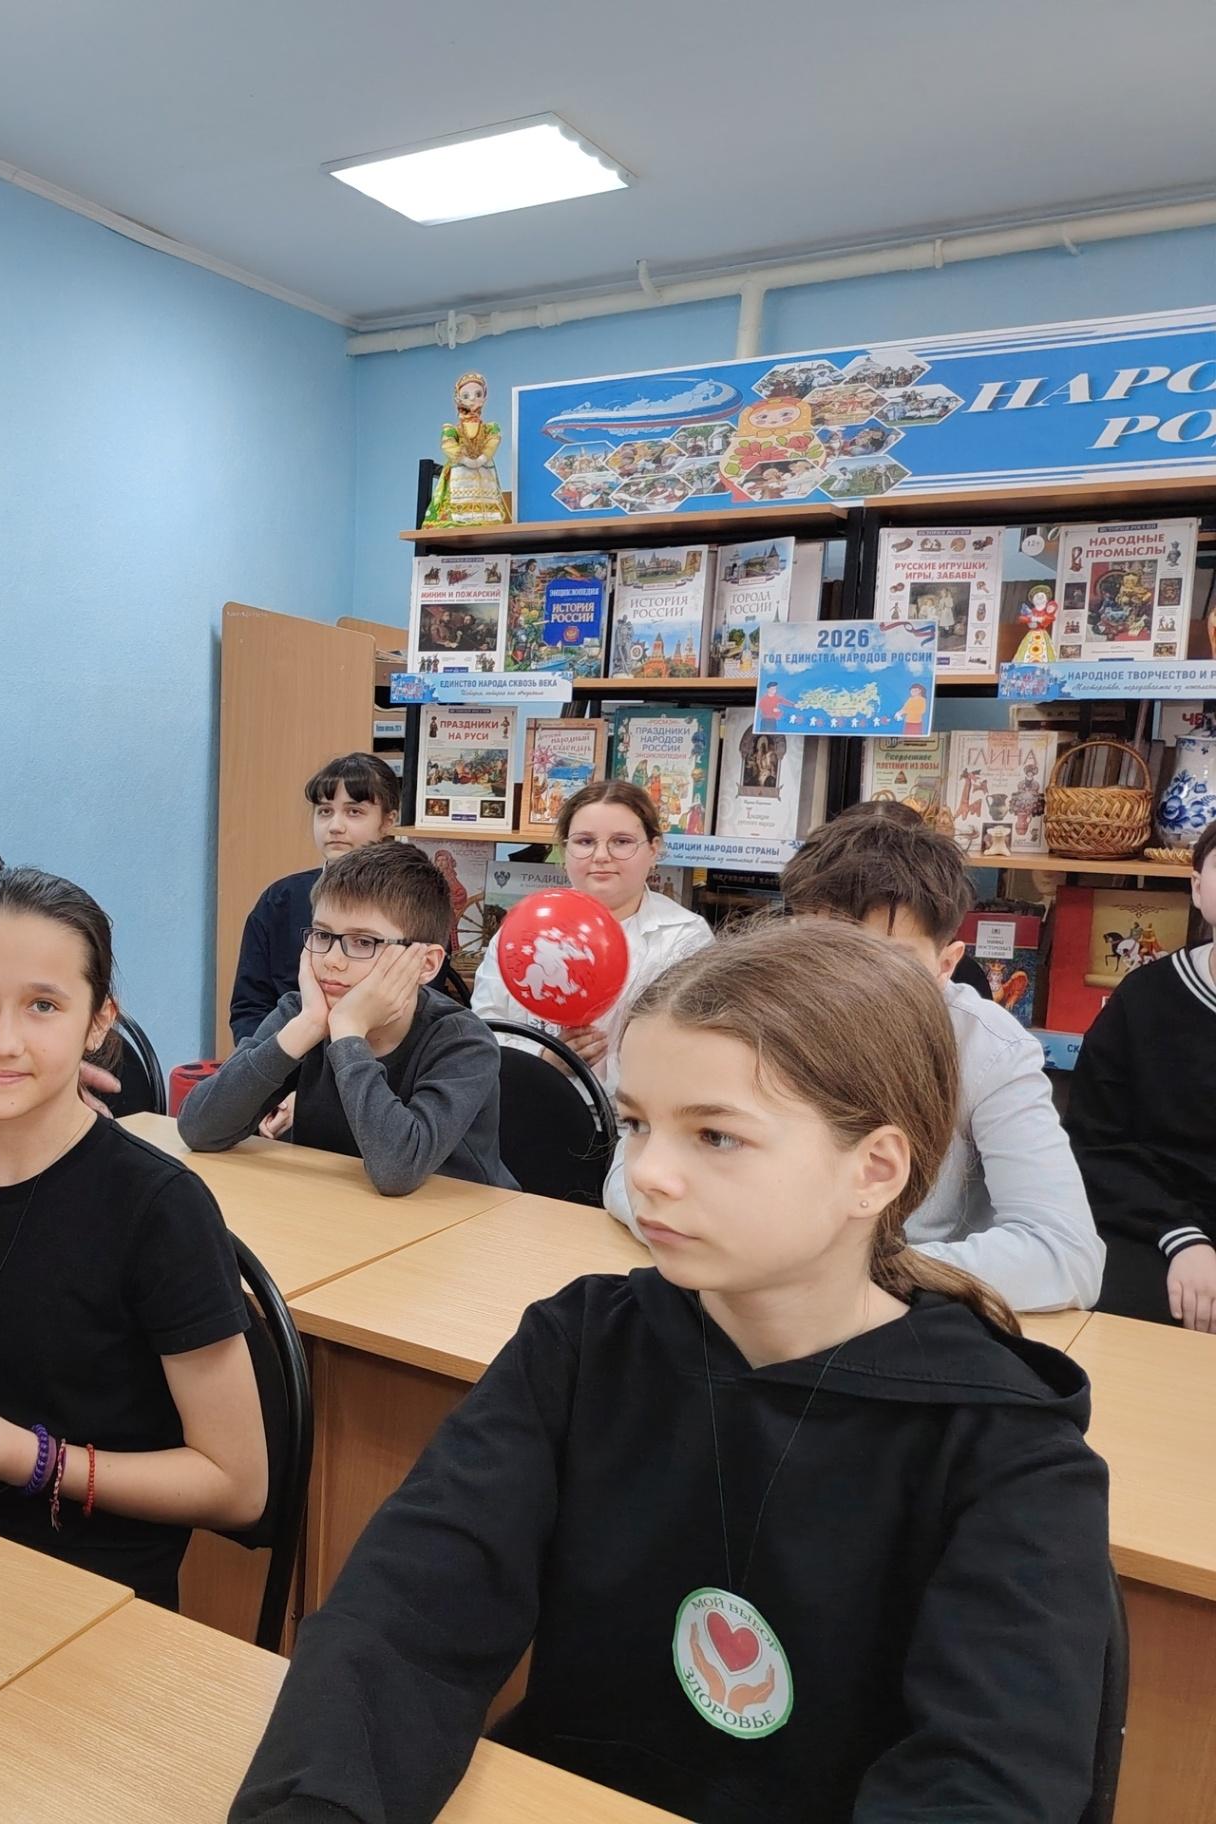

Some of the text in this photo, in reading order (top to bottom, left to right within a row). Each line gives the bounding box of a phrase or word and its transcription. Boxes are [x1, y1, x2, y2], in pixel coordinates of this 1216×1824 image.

[1086, 409, 1216, 449] РО
[1088, 533, 1165, 547] НАРОДНЫЕ
[1085, 545, 1167, 558] ПРОМЫСЛЫ
[894, 562, 937, 571] РУССКИЕ
[937, 571, 977, 579] ЗАБАВЫ
[420, 591, 447, 599] МИНИН
[455, 588, 502, 599] ПОЖАРСКИЙ
[732, 590, 772, 604] ГОРОДА
[552, 602, 595, 613] ИСТОРИЯ
[630, 595, 689, 609] ИСТОРИЯ
[633, 606, 685, 619] РОССИИ
[729, 602, 773, 616] РОССИИ
[550, 612, 595, 624] РОССИИ
[817, 628, 871, 648] 2026
[763, 654, 782, 665] ГОД
[785, 653, 836, 664] ЕДИНСТВА
[839, 652, 887, 663] НАРОДОВ
[890, 651, 933, 662] РОССИИ
[1068, 671, 1125, 681] НАРОДНОЕ
[1127, 670, 1197, 680] ТВОРЧЕСТВО
[1199, 670, 1207, 679] И
[440, 679, 558, 688] ЕДИНСТВО НАРОДА СКВОЗЬ ВЕКА
[439, 720, 499, 730] ПРАЗДНИКИ
[635, 727, 691, 735] ПРАЗДНИКИ
[448, 732, 489, 741] НА РУСИ
[640, 735, 684, 744] НАРОДОВ
[641, 744, 681, 752] РОССИИ
[967, 747, 1038, 766] ГЛИНА
[663, 841, 780, 856] РАДИЦИИ НАРОДОВ СТРАНЫ
[691, 1597, 779, 1652] МОЙ ВЫБОР
[684, 1666, 776, 1728] ЗДОРОВЬЕ
